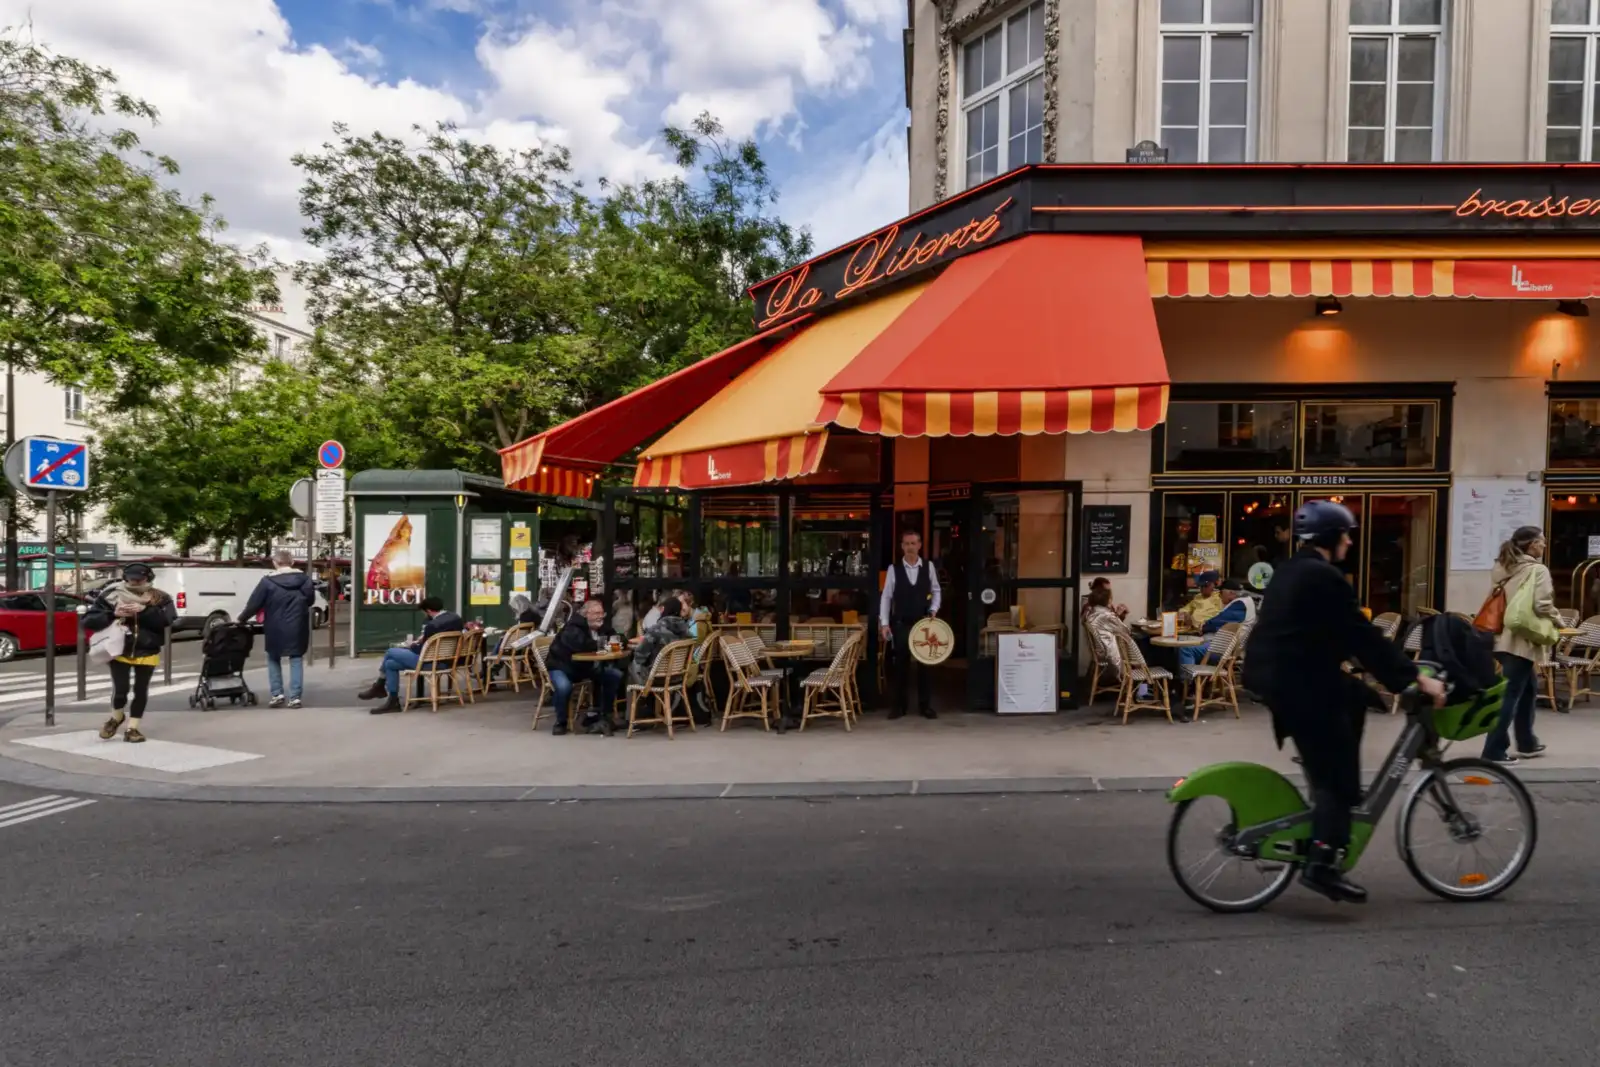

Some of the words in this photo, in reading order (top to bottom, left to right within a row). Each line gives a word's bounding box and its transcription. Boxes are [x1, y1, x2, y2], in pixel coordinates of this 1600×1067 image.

[758, 264, 823, 328] La
[834, 196, 1013, 299] Liberté
[1257, 476, 1293, 484] BISTRO
[1299, 476, 1346, 484] PARISIEN
[367, 588, 422, 604] PUCCI
